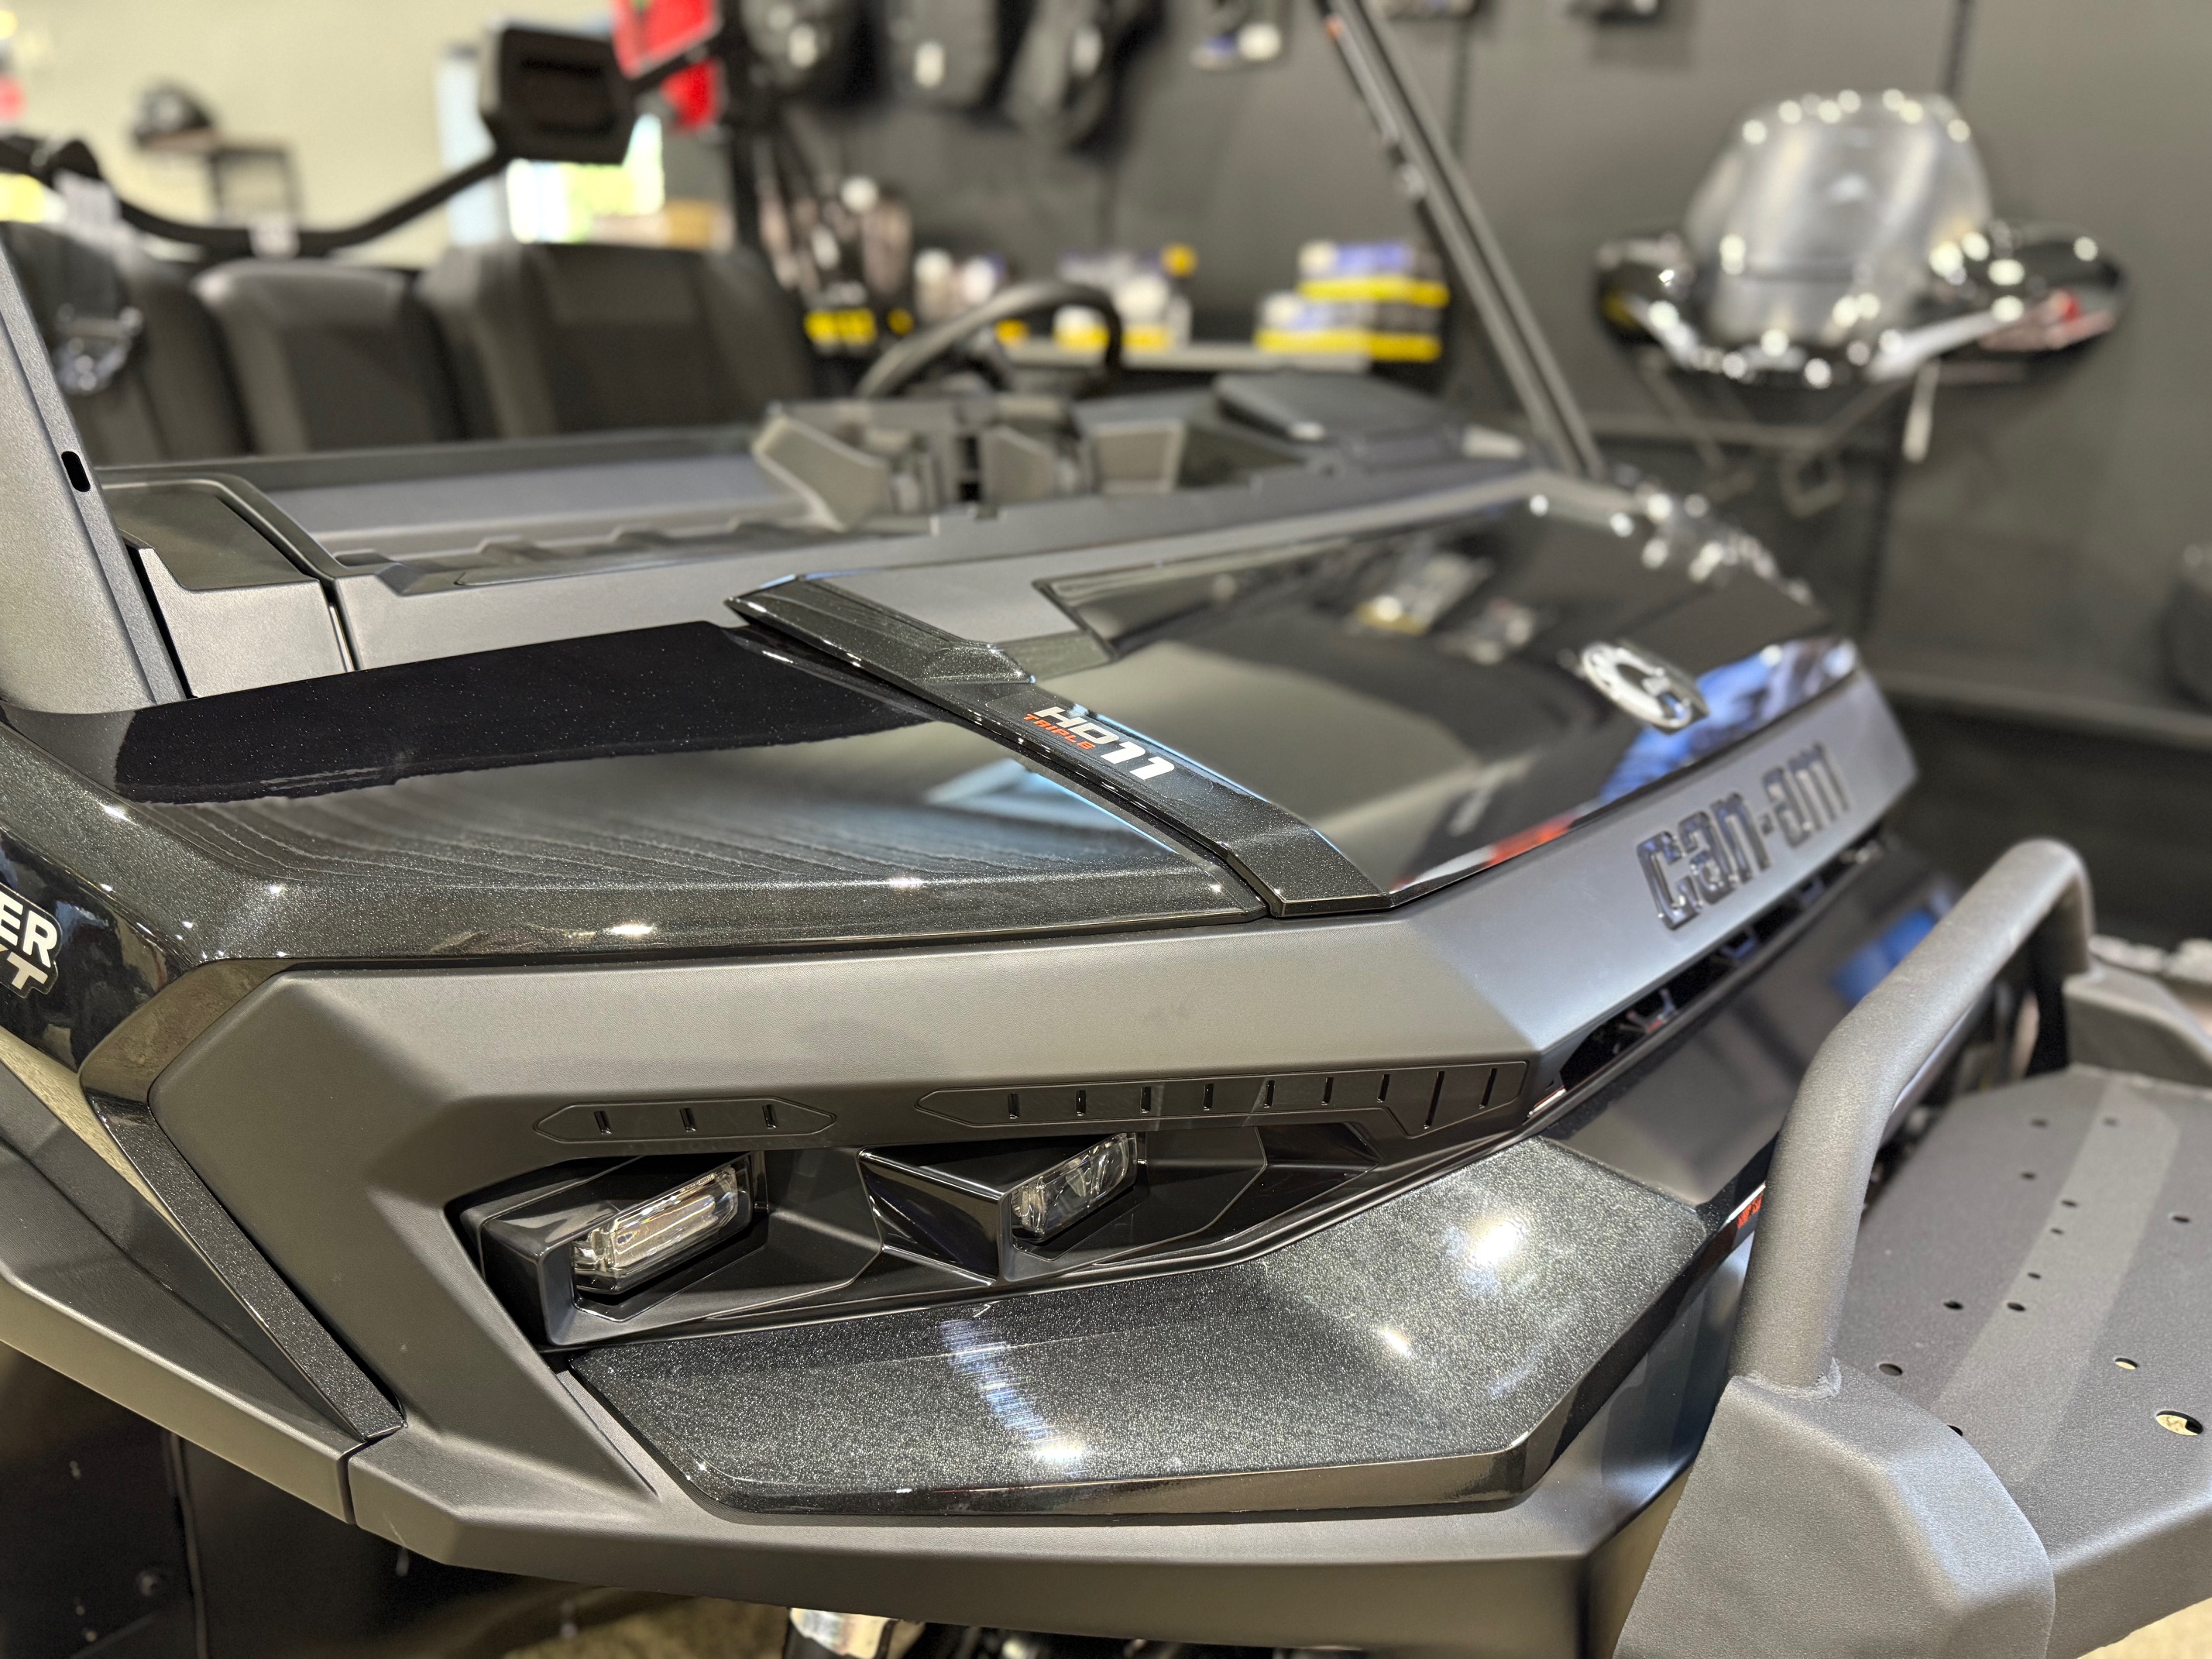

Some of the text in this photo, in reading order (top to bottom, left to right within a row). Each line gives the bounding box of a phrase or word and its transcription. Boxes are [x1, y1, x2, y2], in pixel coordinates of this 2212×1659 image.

[1024, 713, 1097, 750] TRIPLE
[1033, 706, 1175, 781] HD11
[0, 891, 58, 968] ER
[0, 944, 49, 990] T
